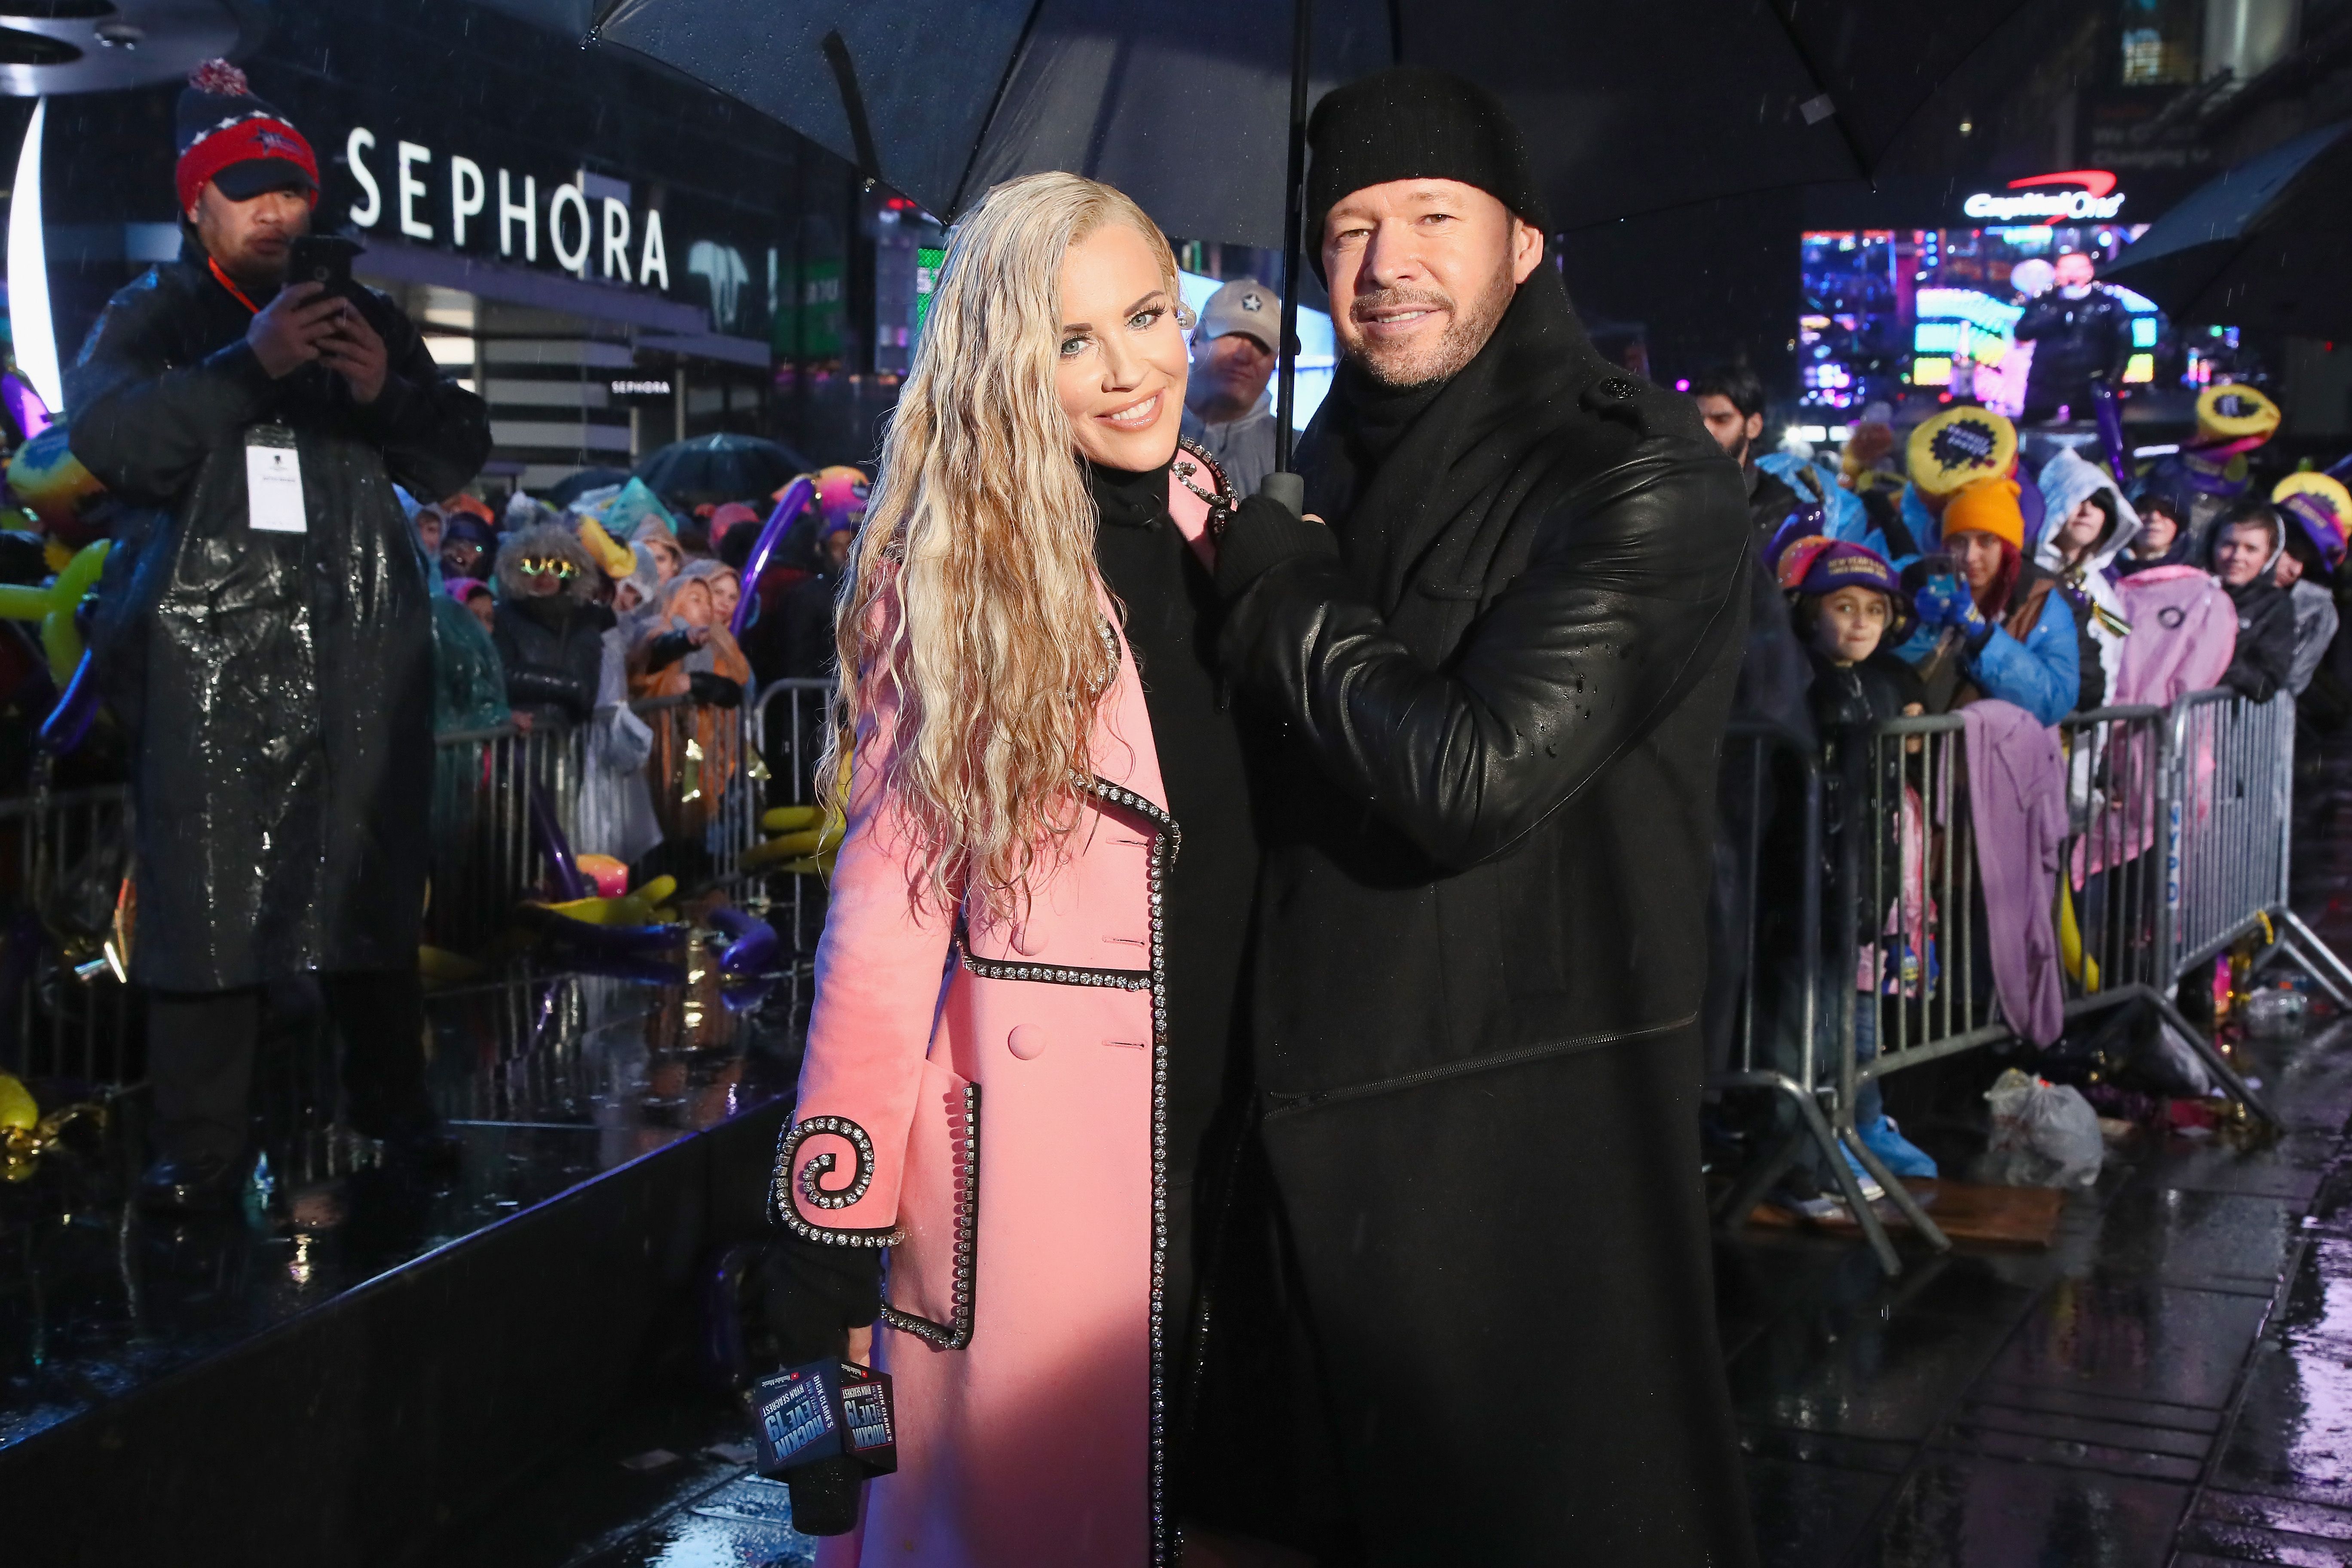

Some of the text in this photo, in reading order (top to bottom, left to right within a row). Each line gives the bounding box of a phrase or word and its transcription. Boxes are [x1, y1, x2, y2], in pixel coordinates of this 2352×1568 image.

[347, 127, 669, 291] SEPHORA
[611, 381, 670, 394] SEPHORA
[762, 1379, 775, 1387] Music
[775, 1375, 790, 1384] YouTube
[763, 1384, 804, 1417] RYAN SEACREST
[814, 1375, 833, 1429] DICK CLARK'S
[842, 1387, 862, 1399] SEACREST
[786, 1400, 812, 1430] EVE
[859, 1404, 878, 1425] EVE
[882, 1407, 893, 1442] CLARK'S
